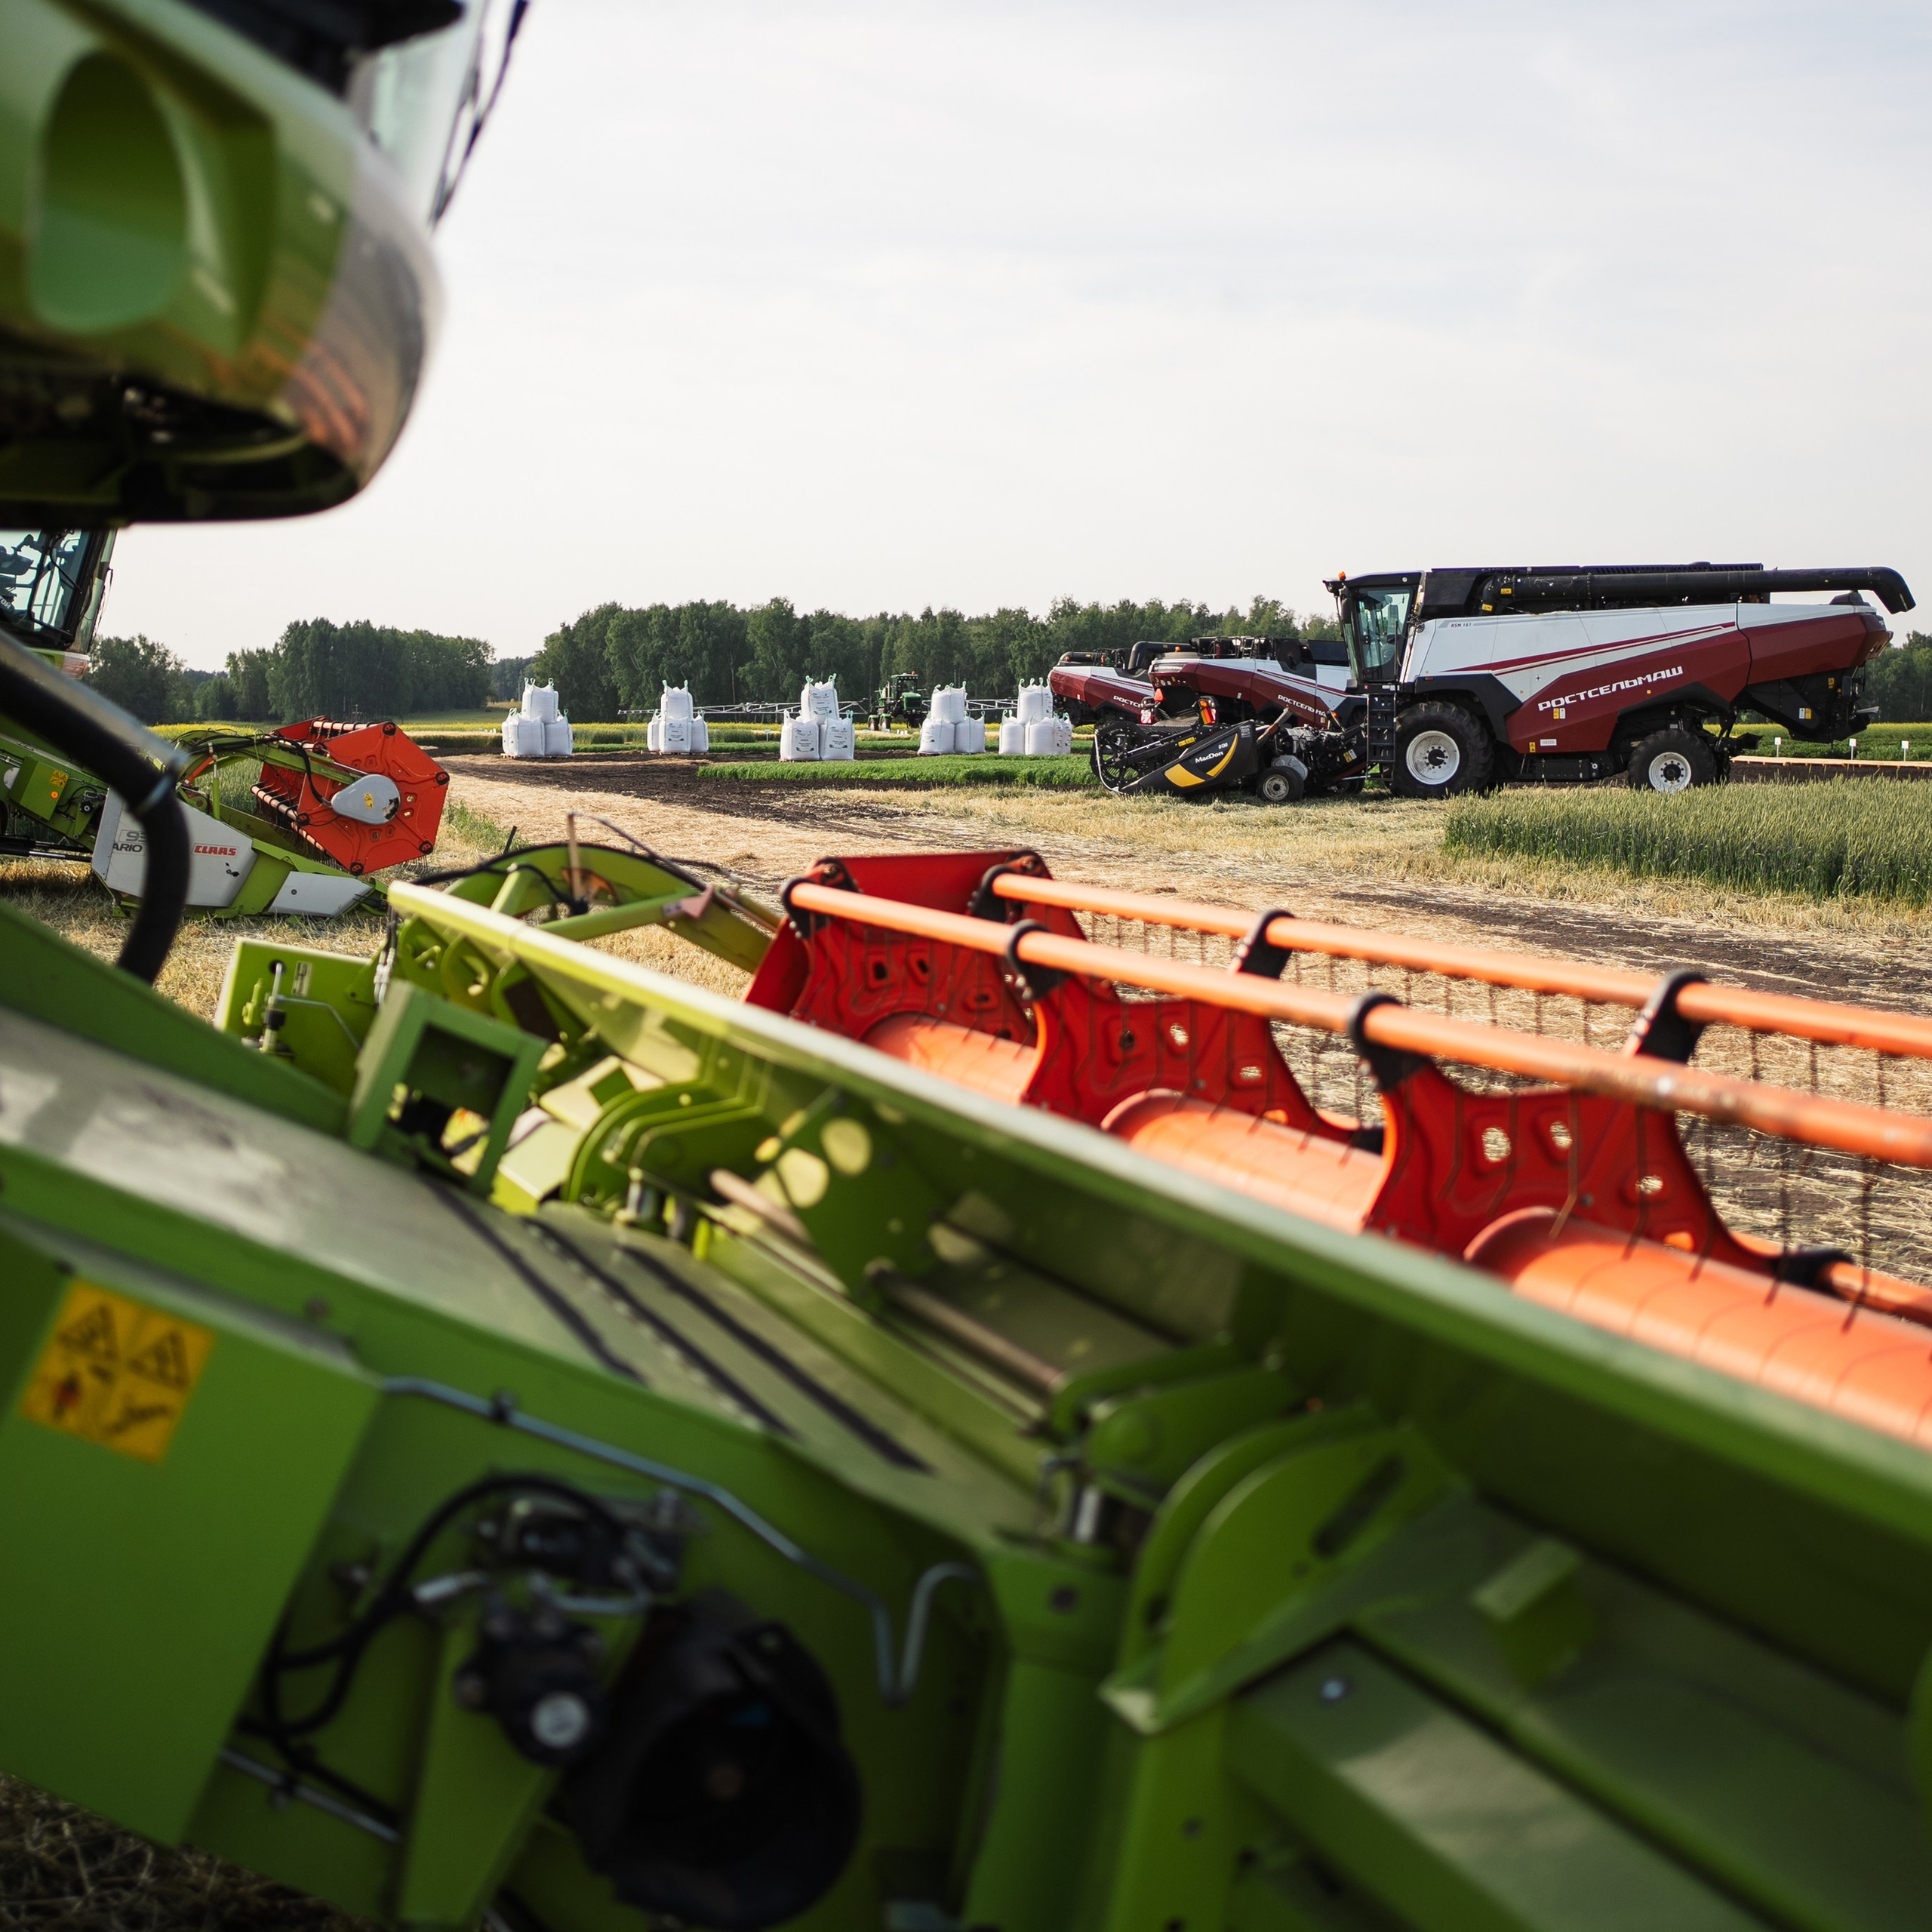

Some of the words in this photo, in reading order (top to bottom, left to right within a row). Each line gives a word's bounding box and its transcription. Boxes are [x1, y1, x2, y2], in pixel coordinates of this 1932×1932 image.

[1537, 666, 1683, 711] РОСТСЕЛЬМАШ
[1278, 694, 1327, 718] РОСТСЕЛЬМА
[1195, 751, 1223, 763] MacDon
[112, 842, 143, 853] ARIO
[194, 845, 236, 856] CLAAS
